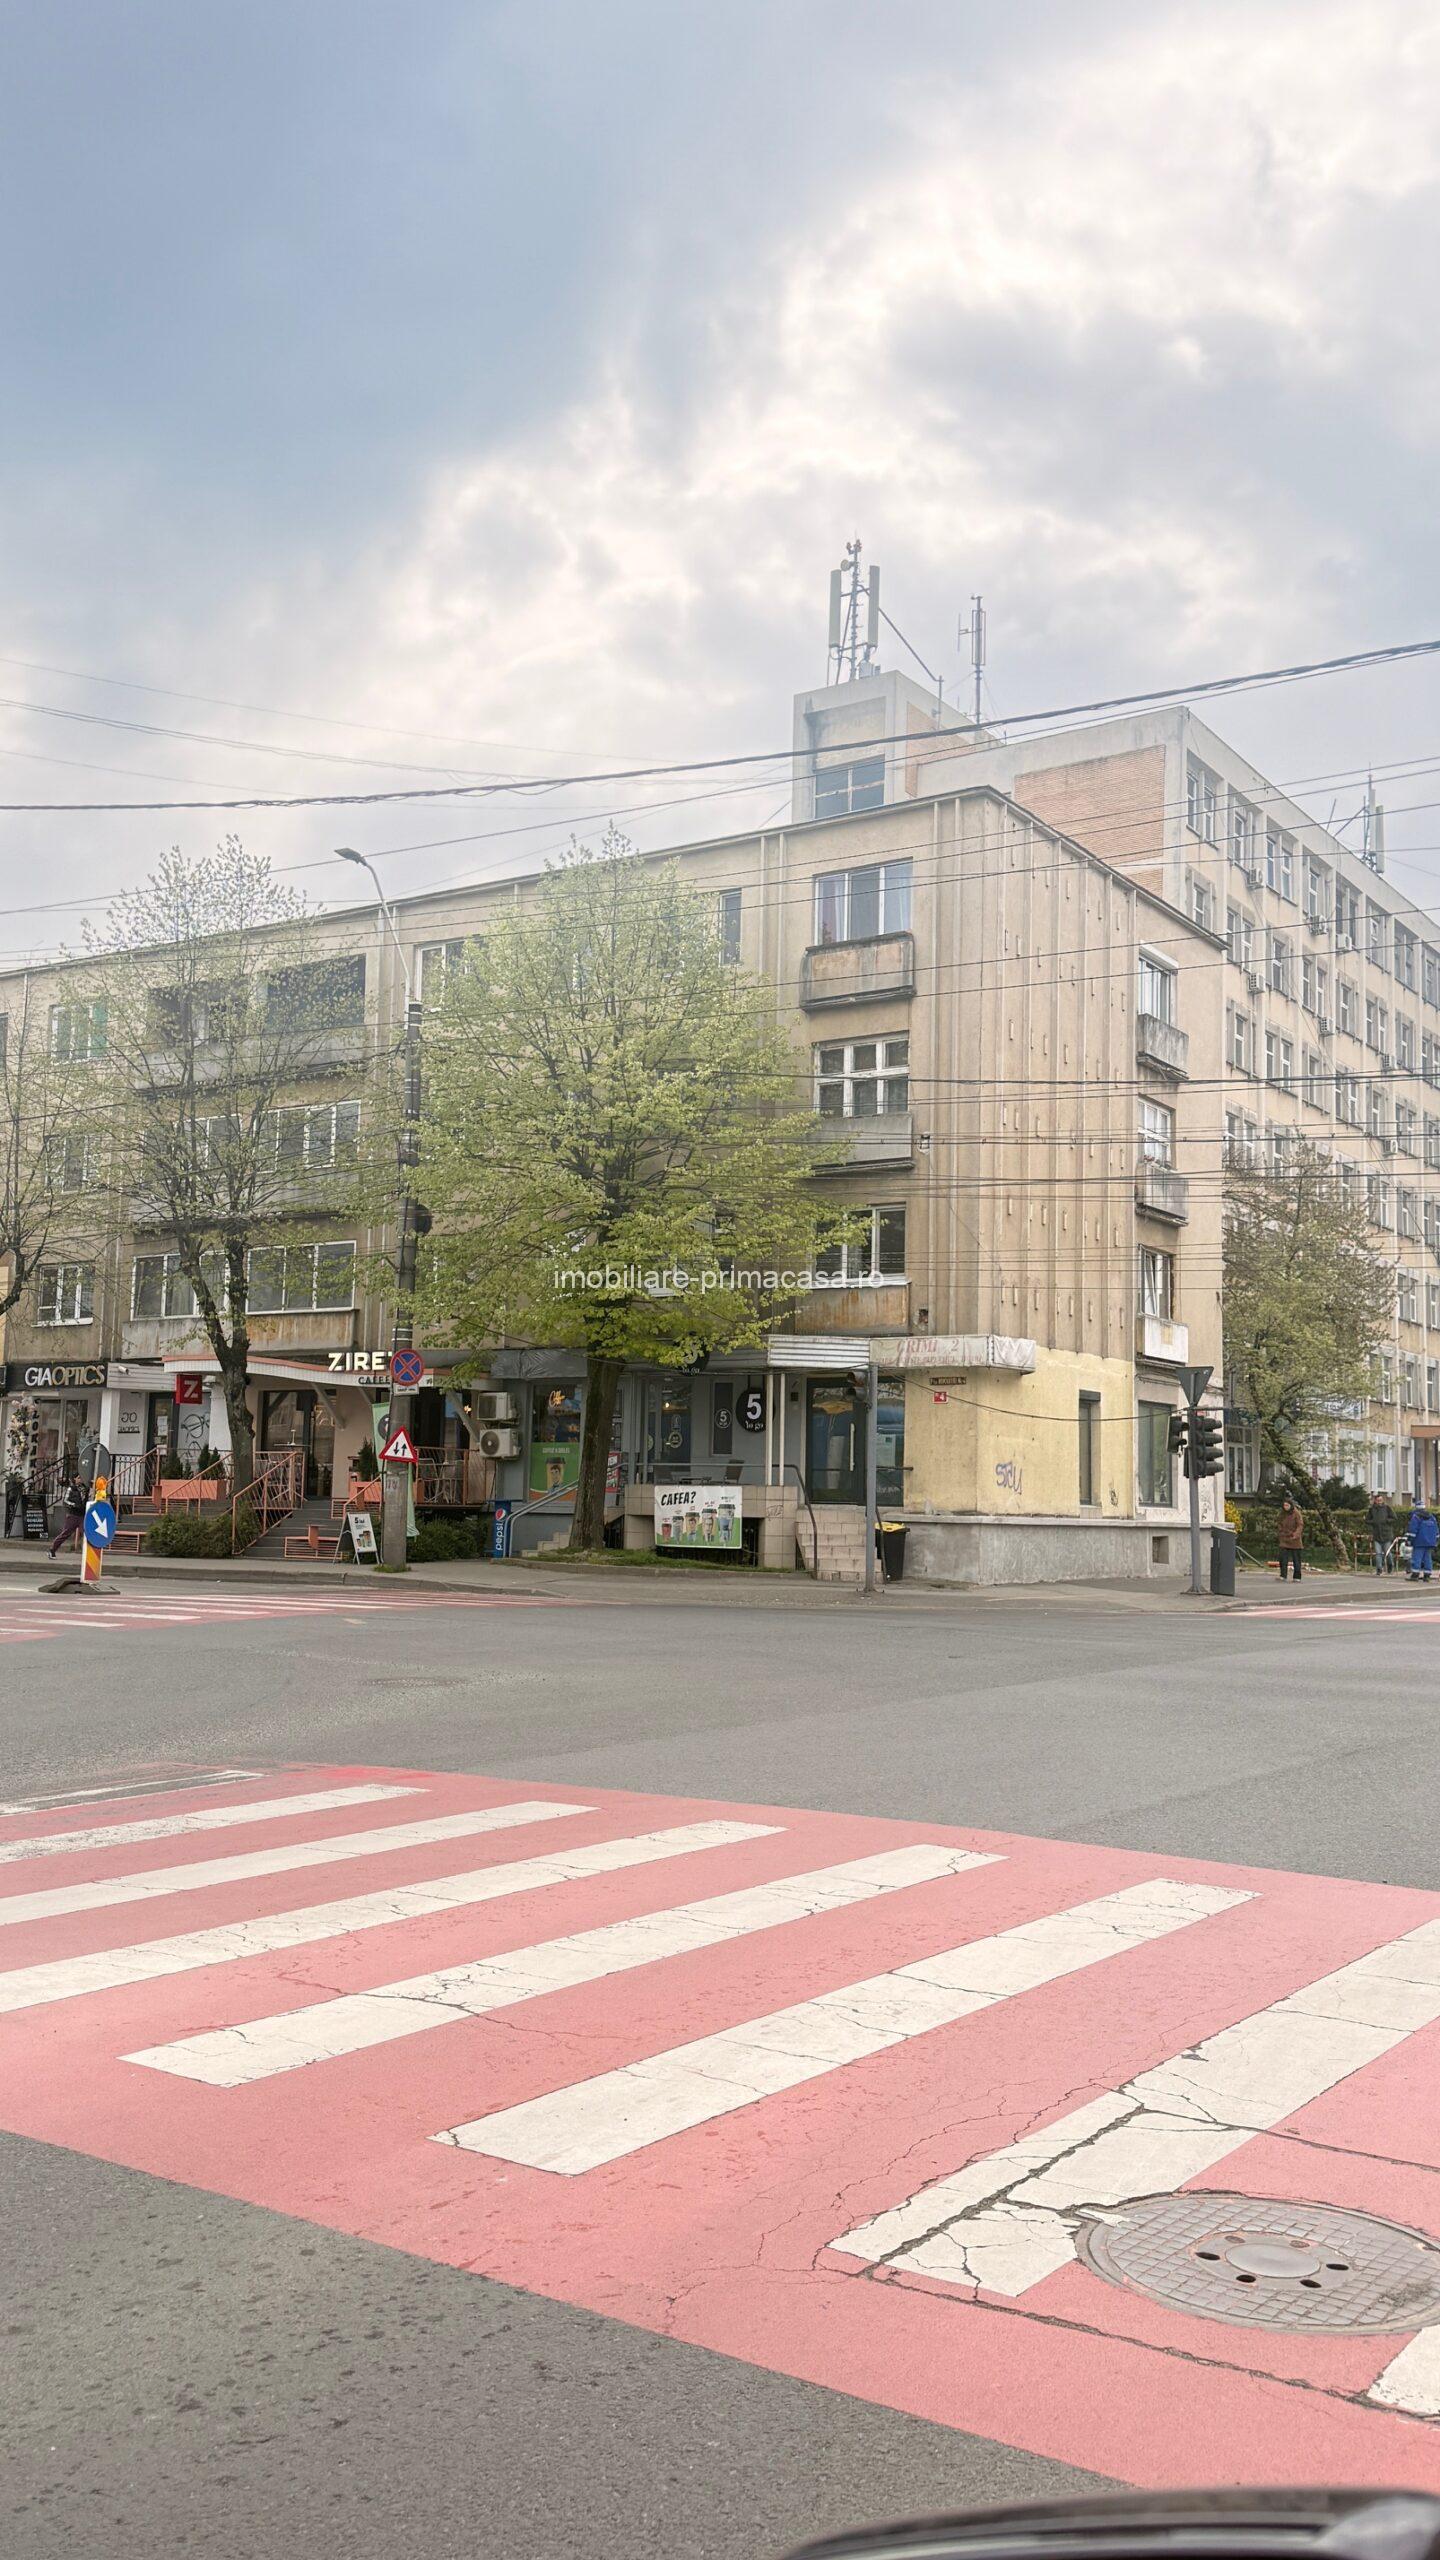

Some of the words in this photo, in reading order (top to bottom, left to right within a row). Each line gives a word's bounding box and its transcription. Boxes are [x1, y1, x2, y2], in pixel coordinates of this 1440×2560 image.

[328, 1350, 393, 1371] ZIRE
[183, 1380, 199, 1399] Z
[719, 1410, 728, 1422] 5
[746, 1393, 762, 1420] 5
[660, 1490, 697, 1506] CAFEA?
[495, 1519, 504, 1551] pepsi
